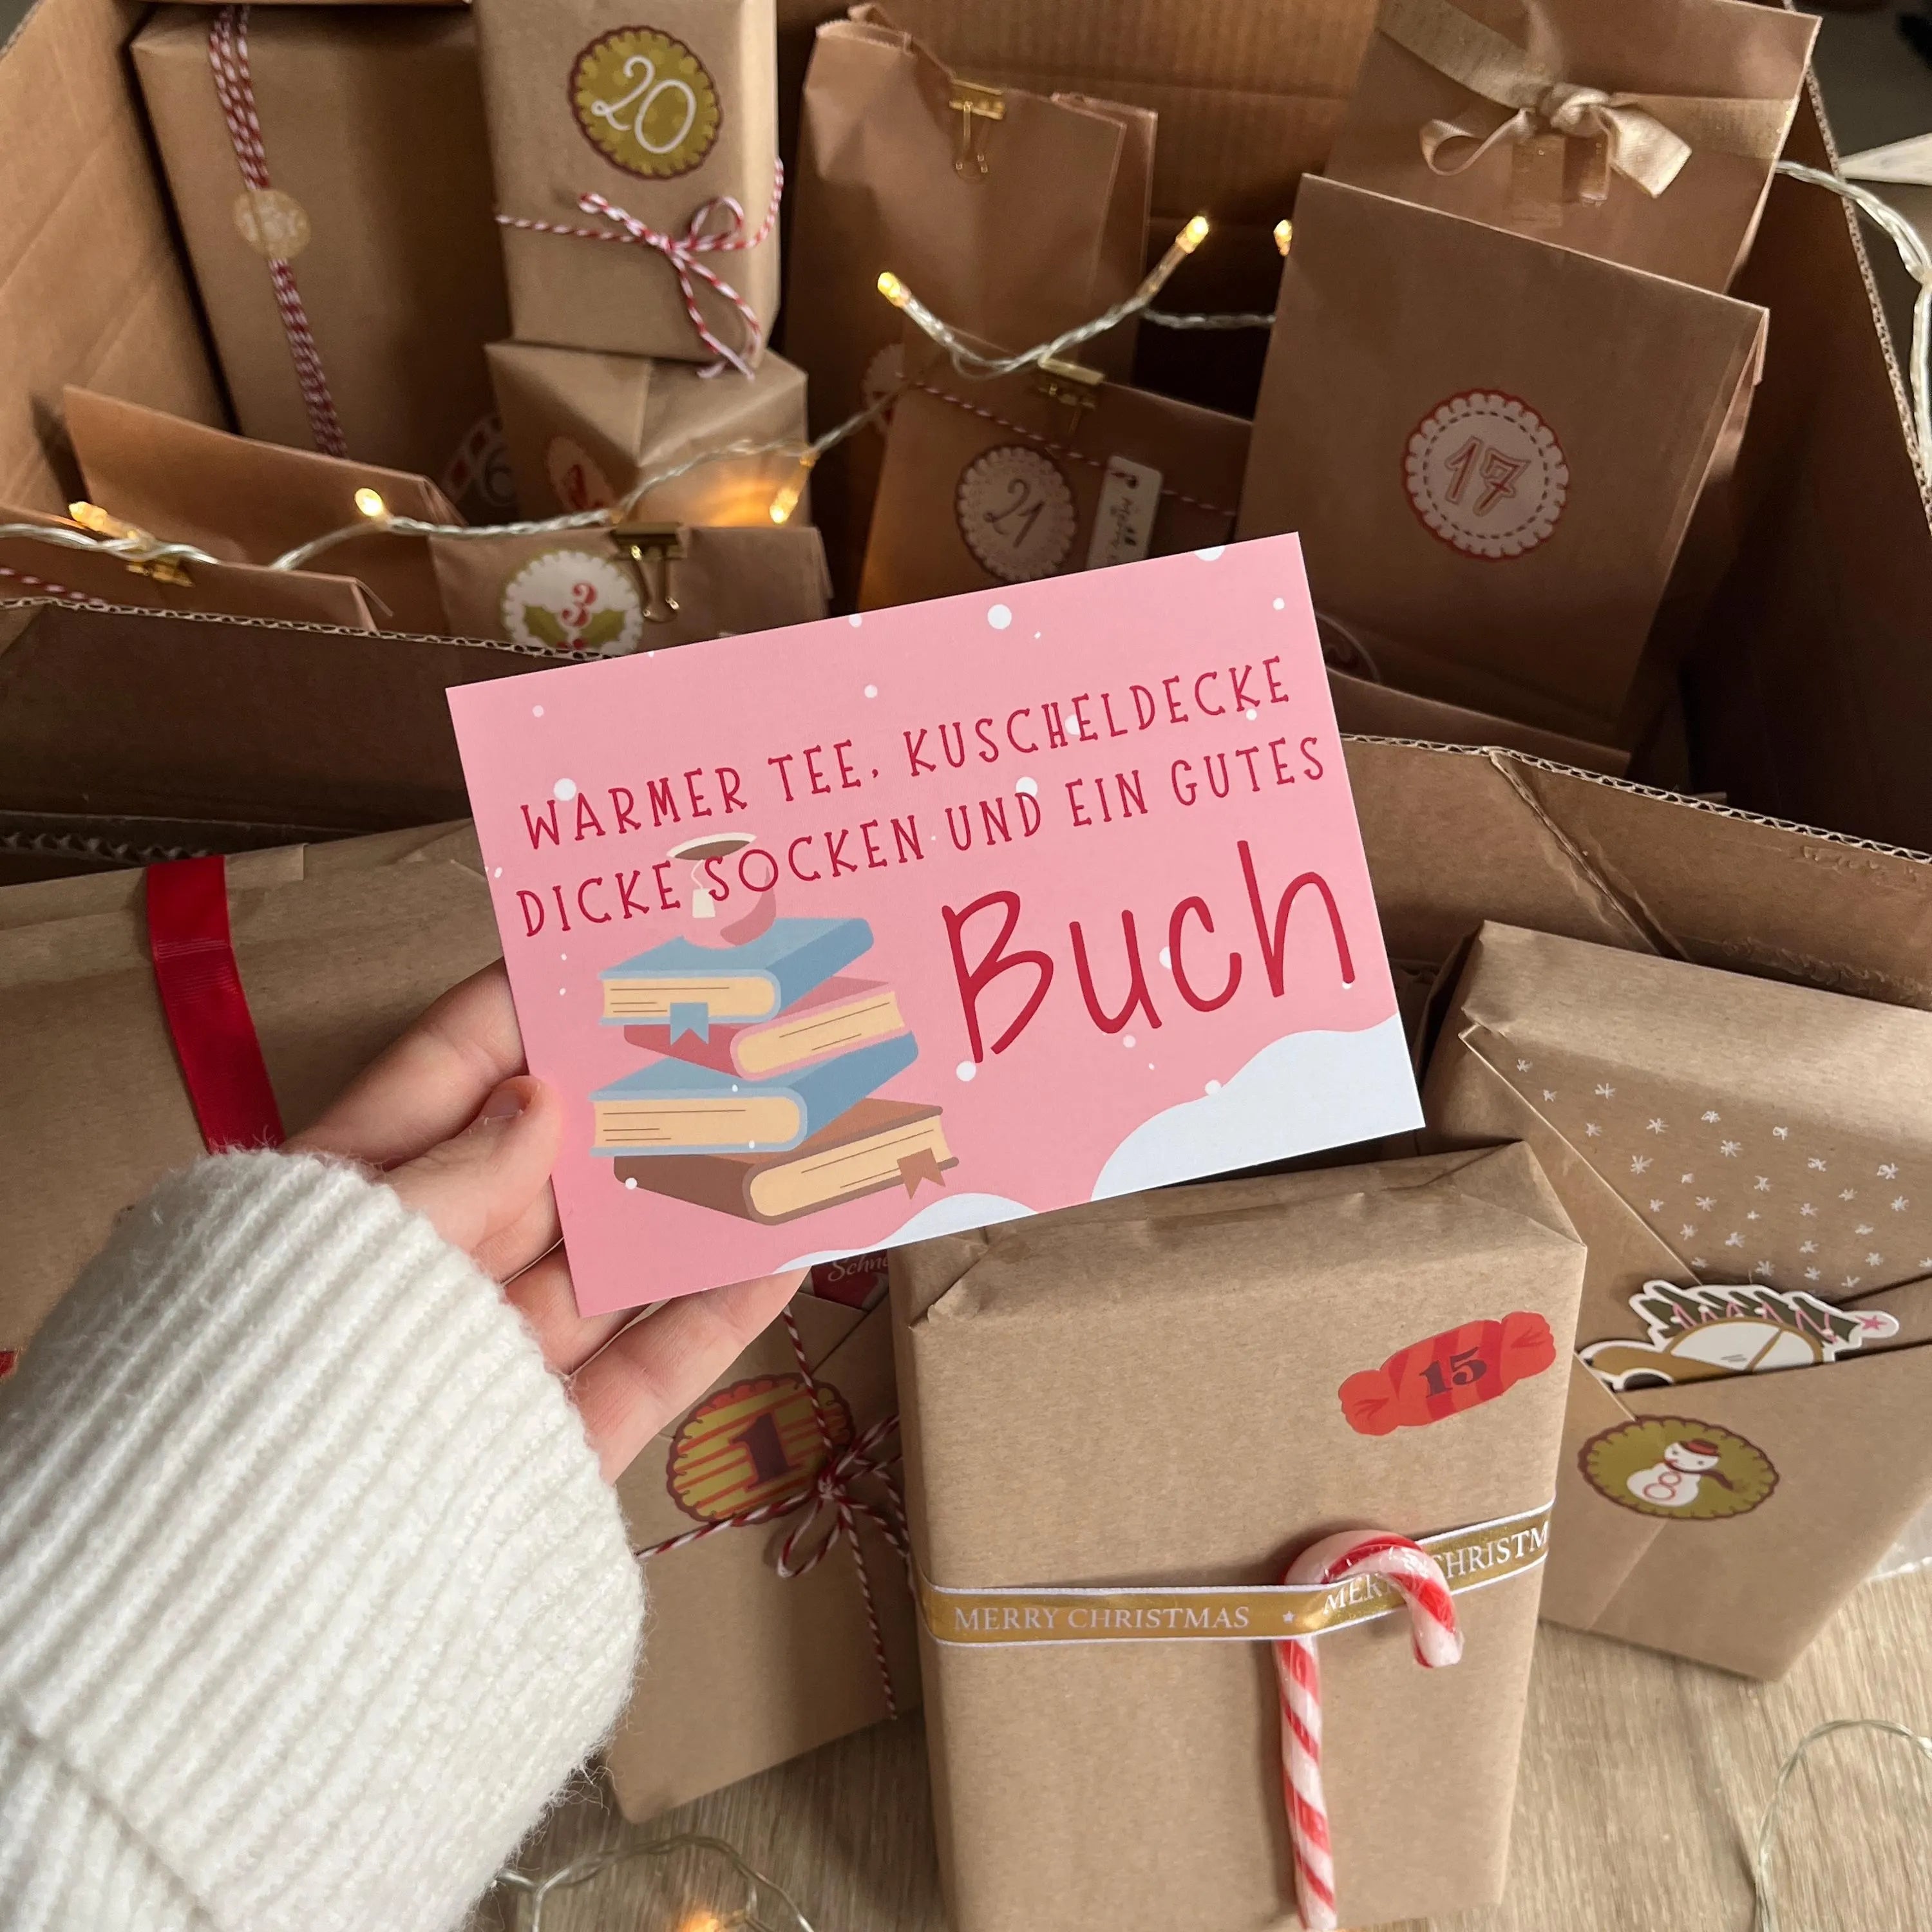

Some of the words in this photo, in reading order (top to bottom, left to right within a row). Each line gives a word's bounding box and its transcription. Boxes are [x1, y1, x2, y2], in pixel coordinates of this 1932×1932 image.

[591, 55, 697, 155] 20
[982, 478, 1045, 548] 21
[1444, 435, 1531, 517] 17
[561, 581, 598, 627] 3
[520, 767, 748, 850] WARMER
[767, 741, 880, 802] TEE,
[904, 656, 1289, 777] KUSCHELDECKE
[517, 862, 681, 938] DICKE
[704, 814, 923, 902] SOCKEN
[945, 793, 1041, 851] UND
[1066, 770, 1148, 828] EIN
[1171, 737, 1323, 806] GUTES
[942, 840, 1356, 1064] Buch
[1419, 1346, 1487, 1398] 15
[730, 1411, 802, 1490] 1
[954, 1607, 1058, 1632] MERRY
[1067, 1605, 1249, 1630] CHRISTMAS
